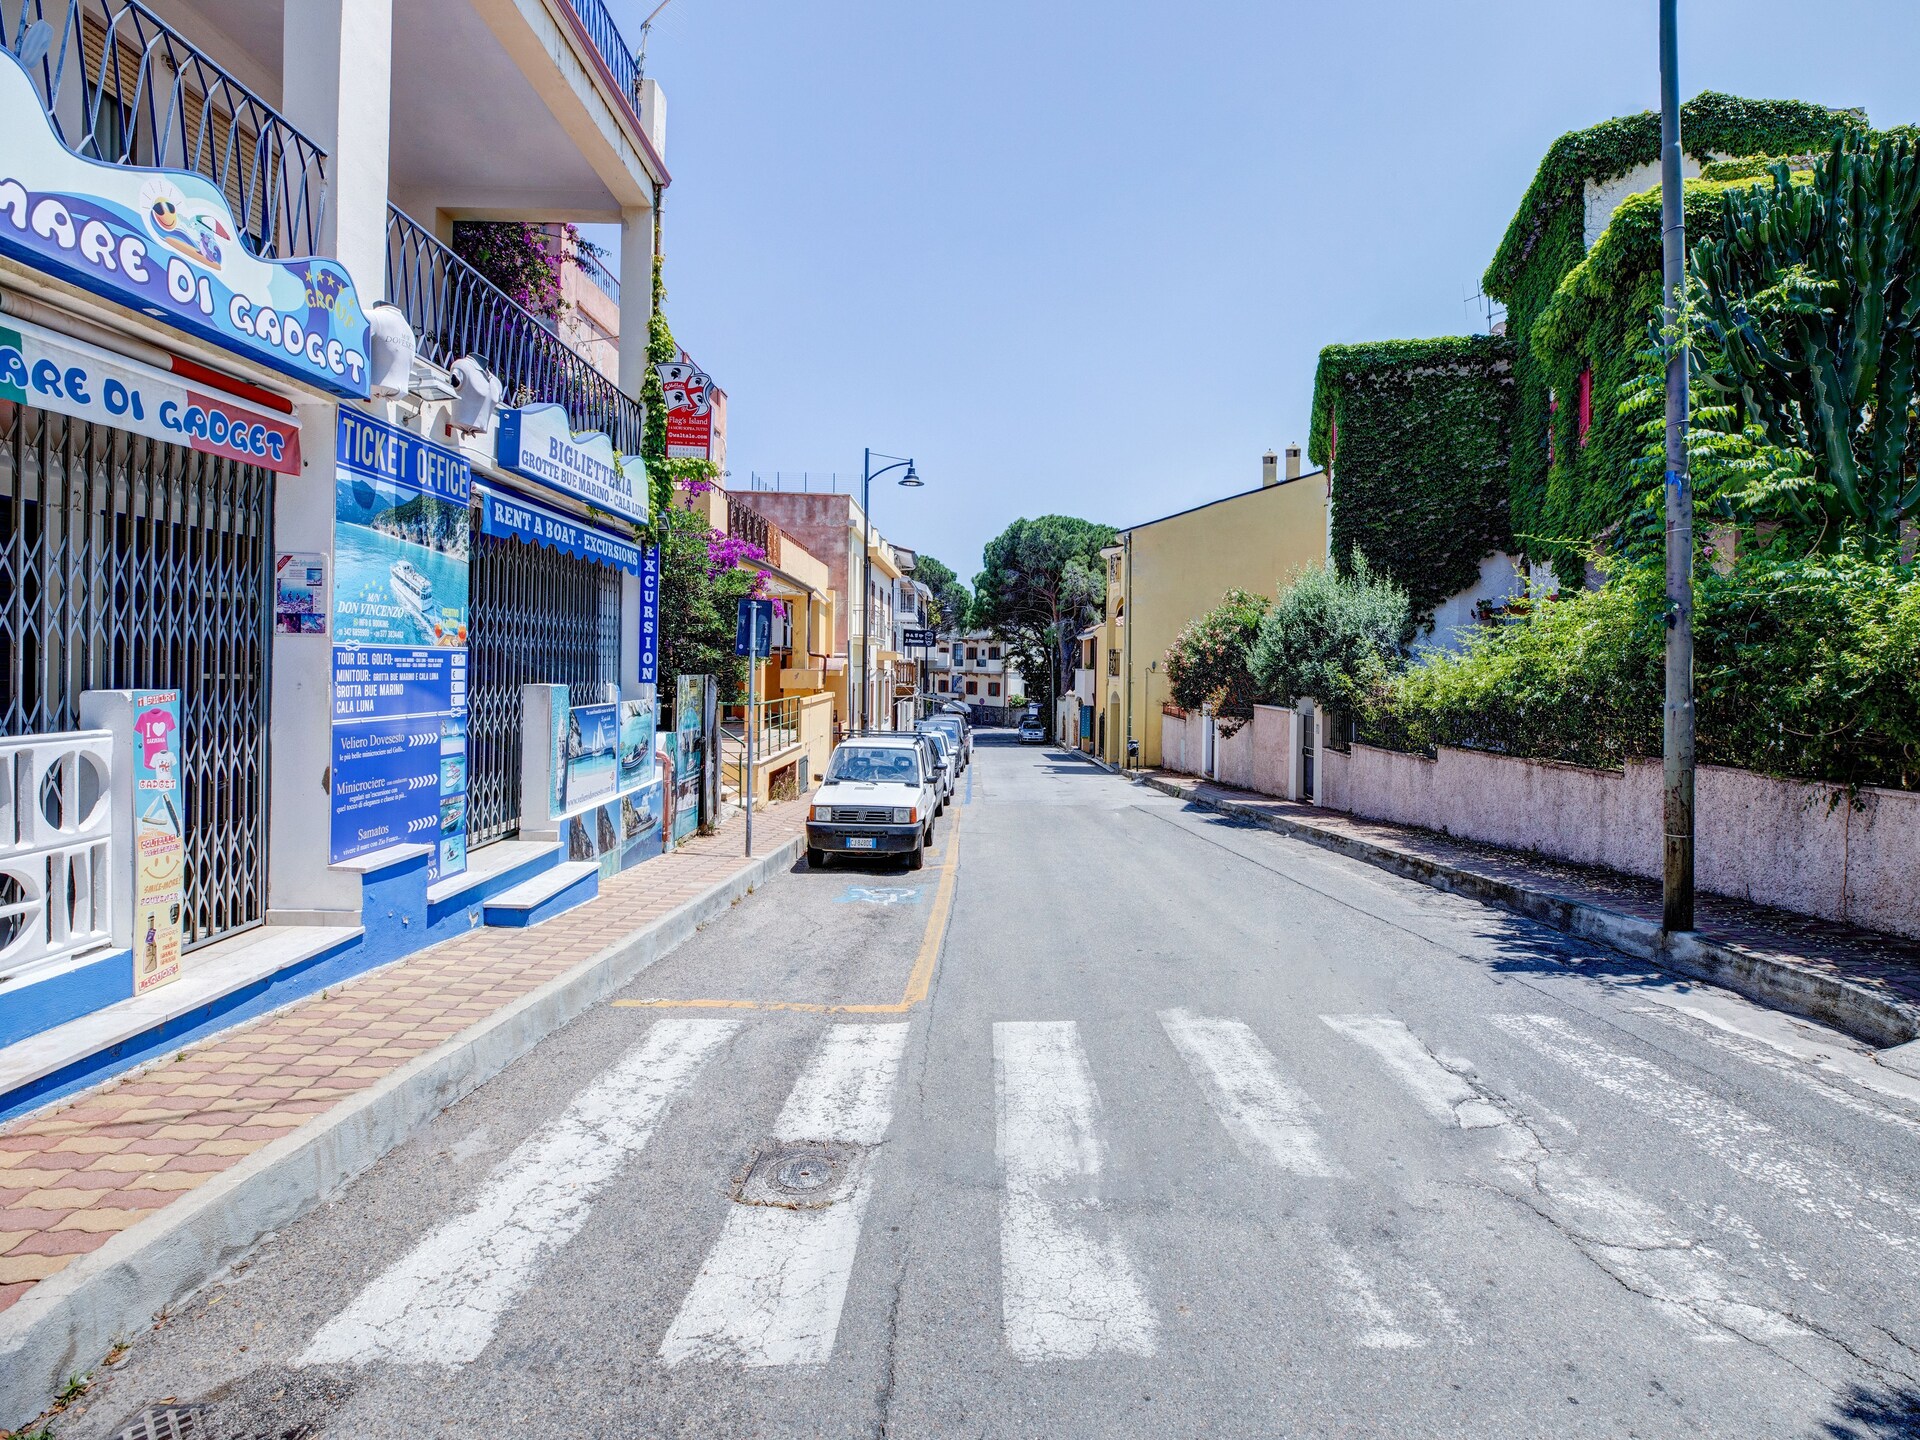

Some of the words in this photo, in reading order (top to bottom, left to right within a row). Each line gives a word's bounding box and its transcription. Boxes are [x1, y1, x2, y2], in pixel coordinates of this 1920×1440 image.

[305, 288, 355, 328] GROUP
[167, 255, 214, 316] DI
[229, 294, 365, 384] GADGET
[103, 378, 145, 420] DI
[159, 400, 285, 462] GADGET
[668, 416, 687, 425] Flag's
[688, 417, 708, 425] Island
[342, 417, 408, 477] TICKET
[417, 449, 468, 499] OFFICE
[549, 436, 633, 498] BIGLIETTERIA
[521, 449, 560, 482] GROTTE
[561, 472, 577, 489] BUE
[578, 477, 609, 502] MARINO
[614, 495, 631, 514] CALA
[631, 503, 648, 520] LUNA
[494, 502, 531, 531] RENT
[533, 517, 543, 536] A
[545, 520, 576, 546] BOAT
[584, 533, 638, 566] EXCURSIONS
[337, 601, 359, 614] DON
[361, 603, 405, 618] VINCENZO
[642, 546, 656, 680] EXCURSION
[336, 652, 355, 665] TOUR
[357, 652, 369, 665] DEL
[371, 653, 393, 666] GOLFO:
[336, 669, 371, 682] MINITOUR:
[373, 673, 389, 681] GROTTA
[390, 673, 398, 681] BUE
[399, 673, 415, 681] MARINO
[336, 685, 362, 698] GROTTA
[364, 684, 378, 697] BUE
[379, 684, 404, 696] MARINO
[336, 701, 354, 714] CALA
[356, 700, 374, 713] LUNA
[146, 722, 151, 738] I
[340, 737, 368, 750] Veliero
[369, 733, 405, 747] Dovesesto
[139, 780, 176, 789] GADGET
[336, 776, 386, 796] Minicrociere
[346, 802, 358, 811] tocco
[358, 824, 390, 841] Samatos
[342, 847, 356, 855] vivere
[140, 892, 179, 905] SOUVENIR
